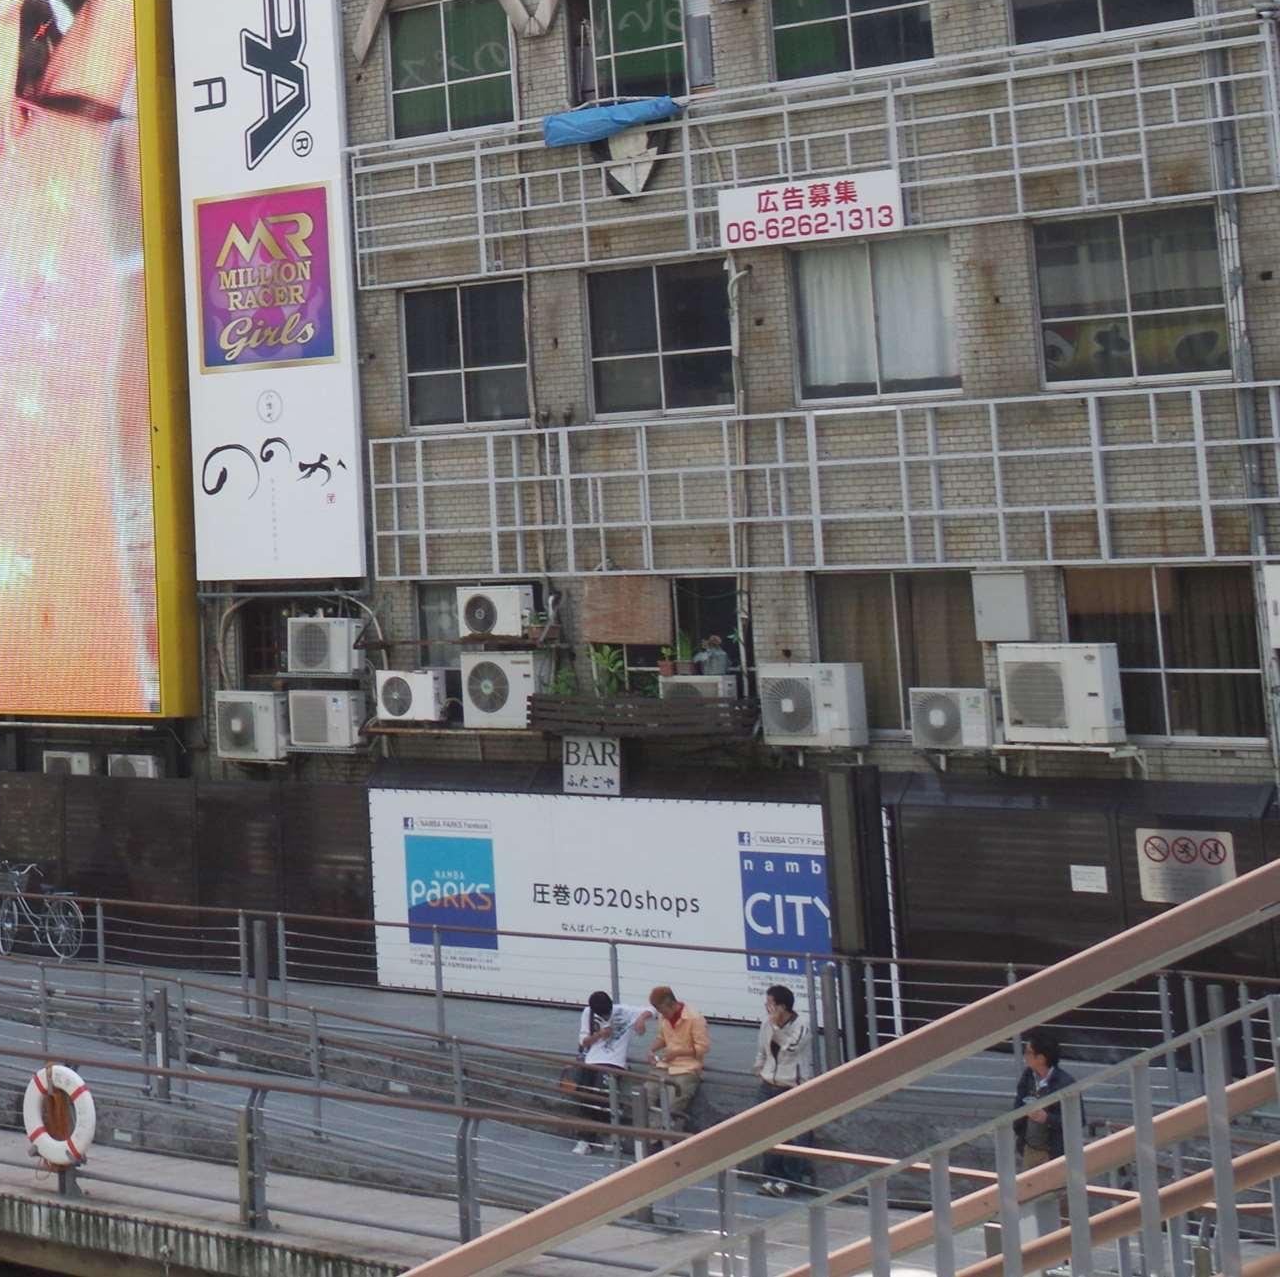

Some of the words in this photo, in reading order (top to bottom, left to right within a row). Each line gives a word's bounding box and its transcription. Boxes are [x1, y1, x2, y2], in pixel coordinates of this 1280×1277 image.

[756, 180, 859, 214] 広告募集
[726, 205, 895, 244] 06-6262-1313
[217, 260, 312, 291] MILLION
[227, 284, 306, 312] RACER
[218, 314, 315, 362] Girls
[563, 741, 619, 768] BAR
[759, 835, 787, 844] NAMBA
[788, 836, 805, 845] CITY
[532, 882, 701, 918] 圧巻の520shops
